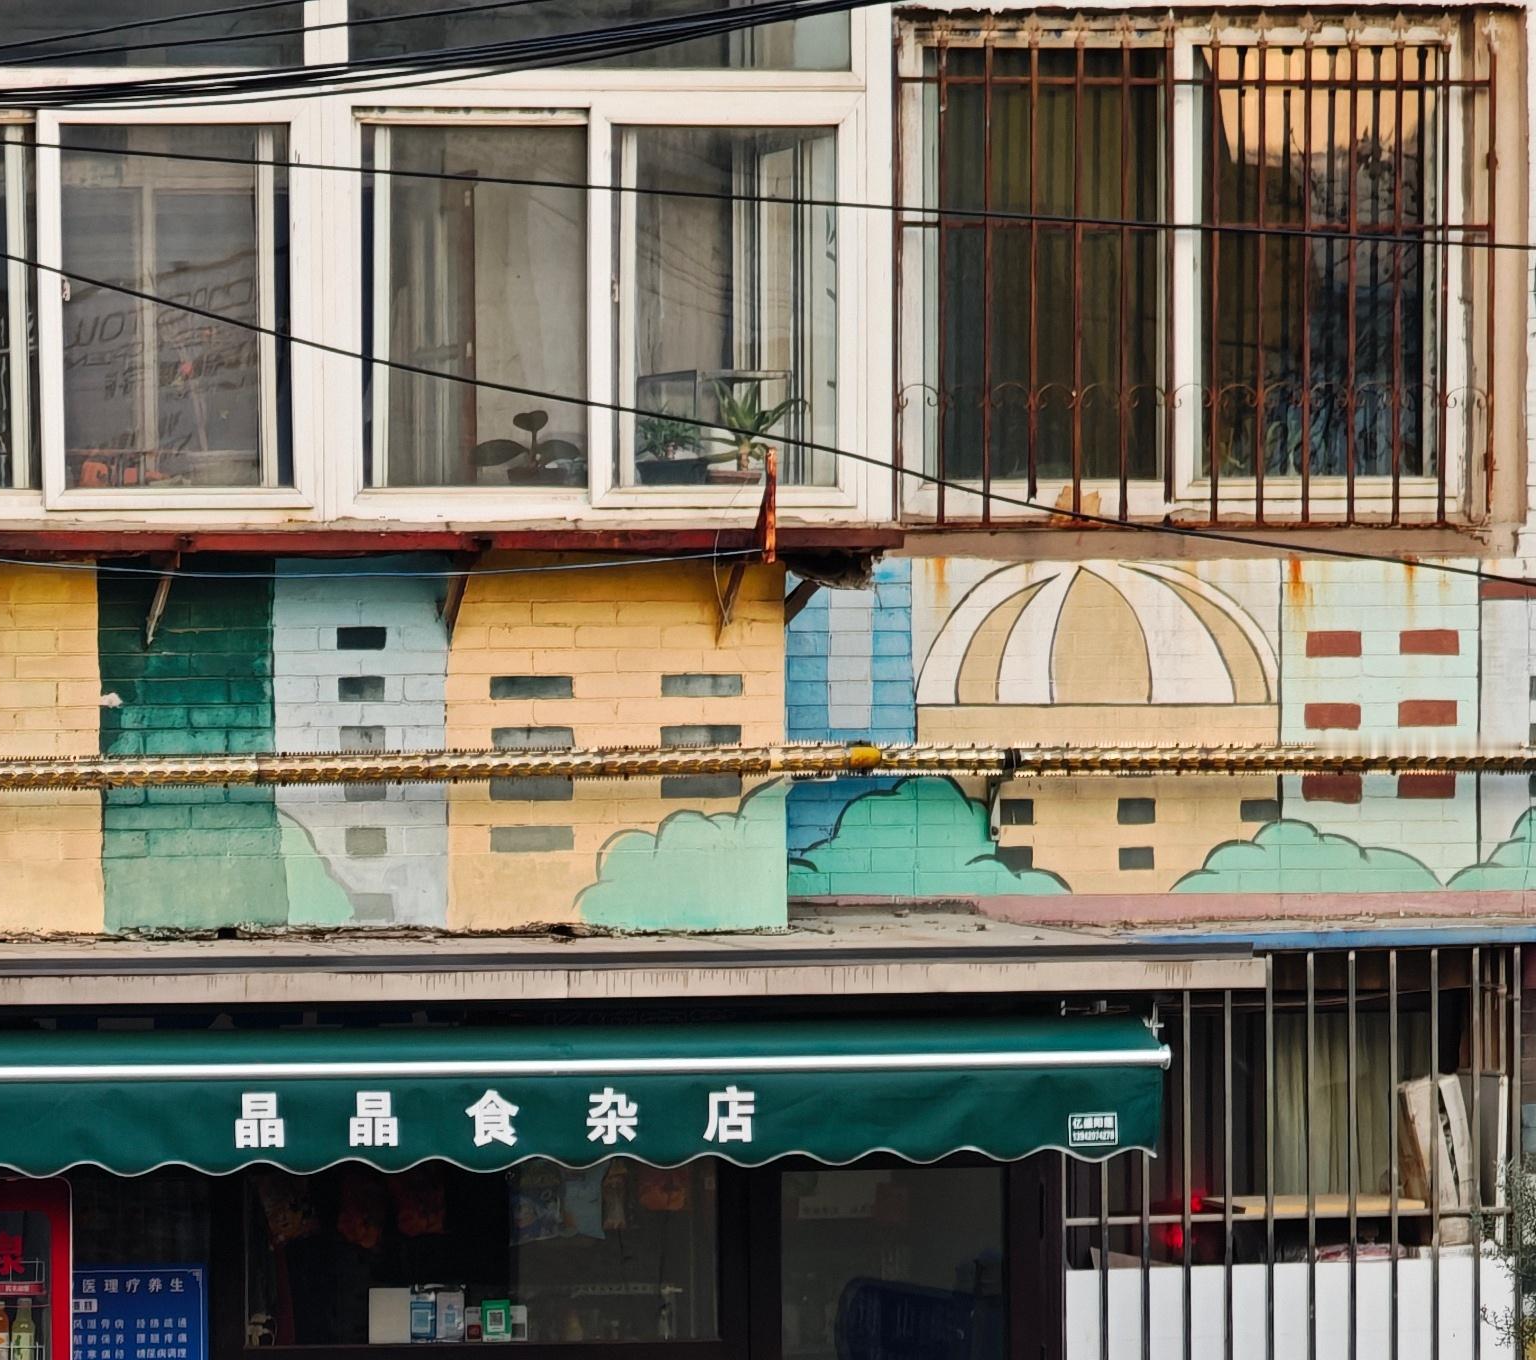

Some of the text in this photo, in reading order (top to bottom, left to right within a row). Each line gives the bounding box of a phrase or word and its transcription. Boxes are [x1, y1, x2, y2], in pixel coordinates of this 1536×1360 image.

[235, 1086, 755, 1149] 晶晶食杂店
[72, 1278, 185, 1293] 医理疗养生
